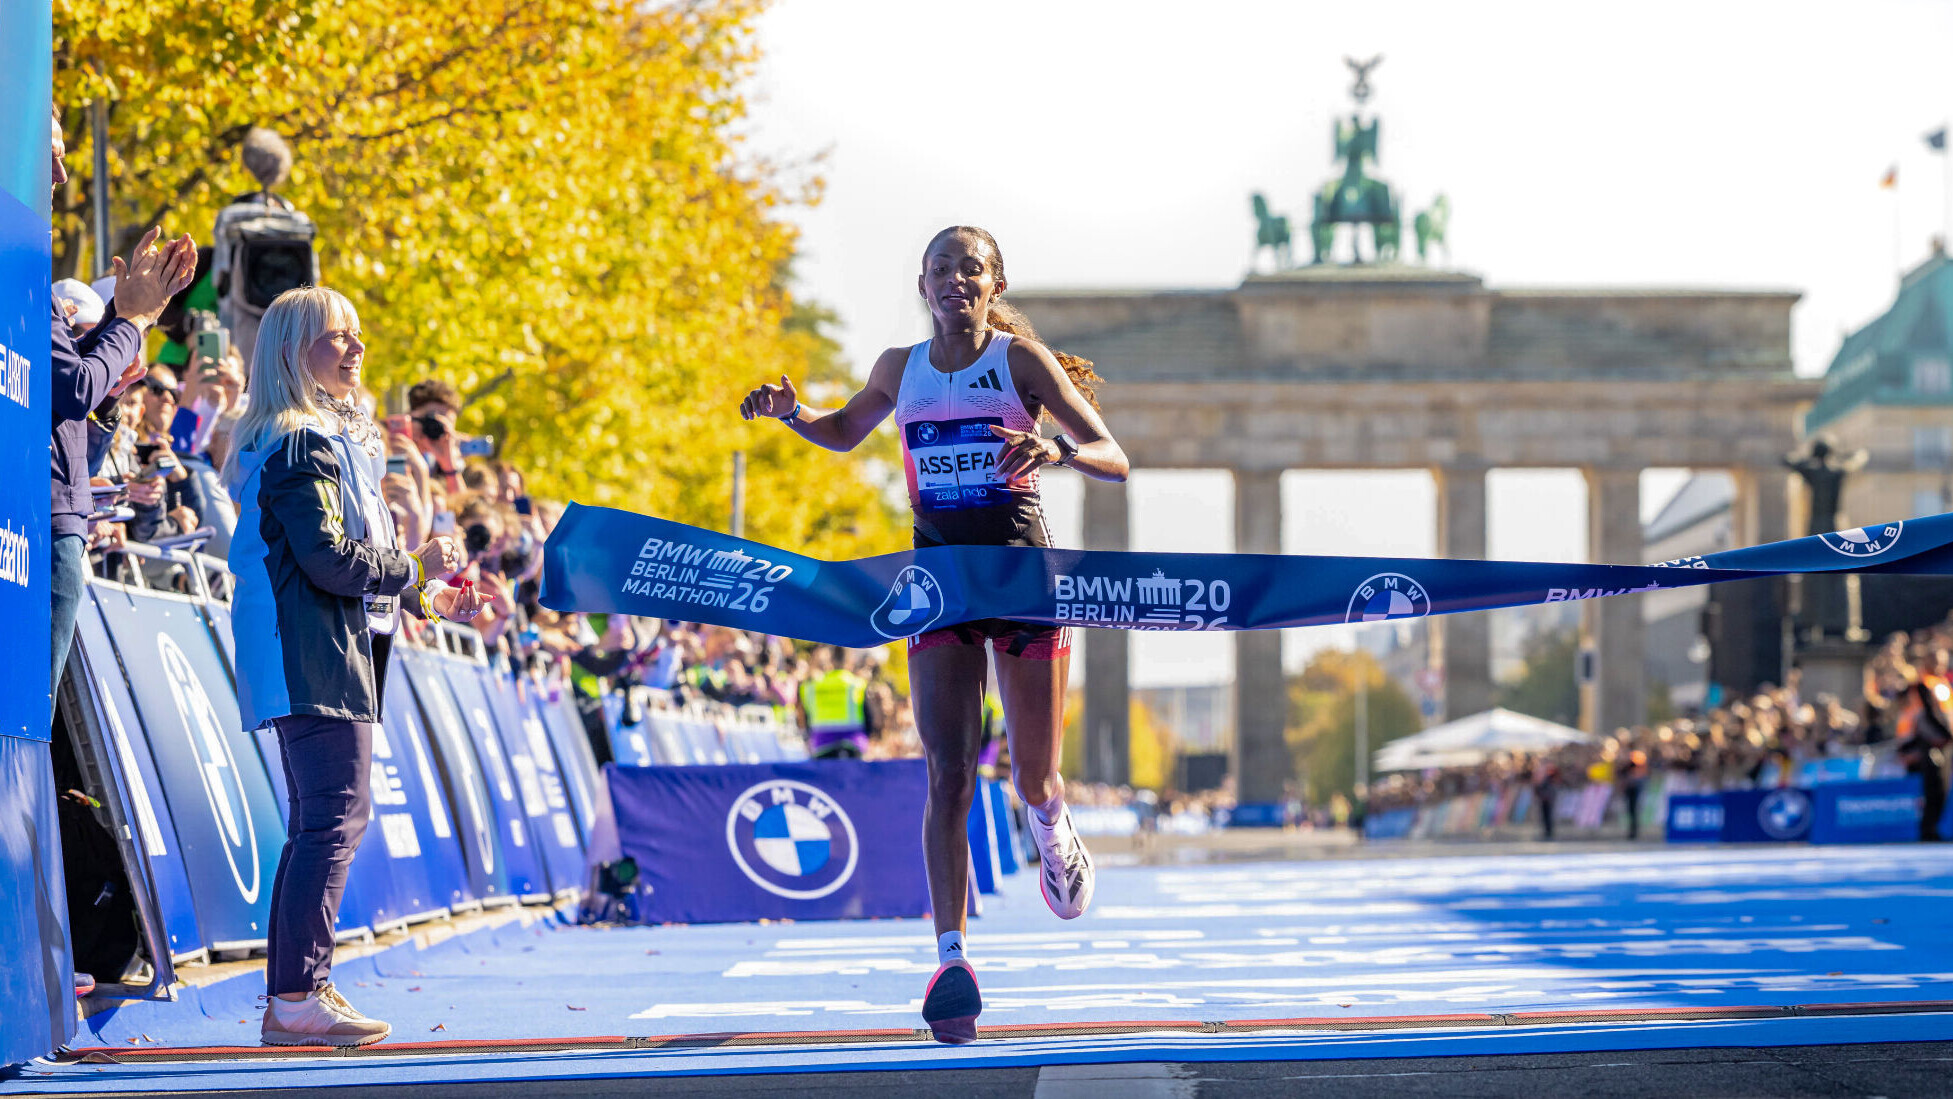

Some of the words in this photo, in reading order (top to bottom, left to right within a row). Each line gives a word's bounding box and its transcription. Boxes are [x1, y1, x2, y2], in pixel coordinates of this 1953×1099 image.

[6, 348, 31, 409] ABBOTT
[920, 452, 995, 475] ASSEFA
[935, 487, 987, 501] zalando
[0, 518, 29, 588] zalando
[638, 537, 713, 566] BMW
[742, 558, 794, 583] 20
[630, 560, 700, 585] BERLIN
[894, 569, 934, 597] BMW
[621, 578, 730, 608] MARATHON
[727, 582, 775, 613] 26
[1054, 574, 1132, 602] BMW
[1184, 579, 1231, 612] 20
[1360, 577, 1423, 601] BMW
[1055, 603, 1135, 622] BERLIN
